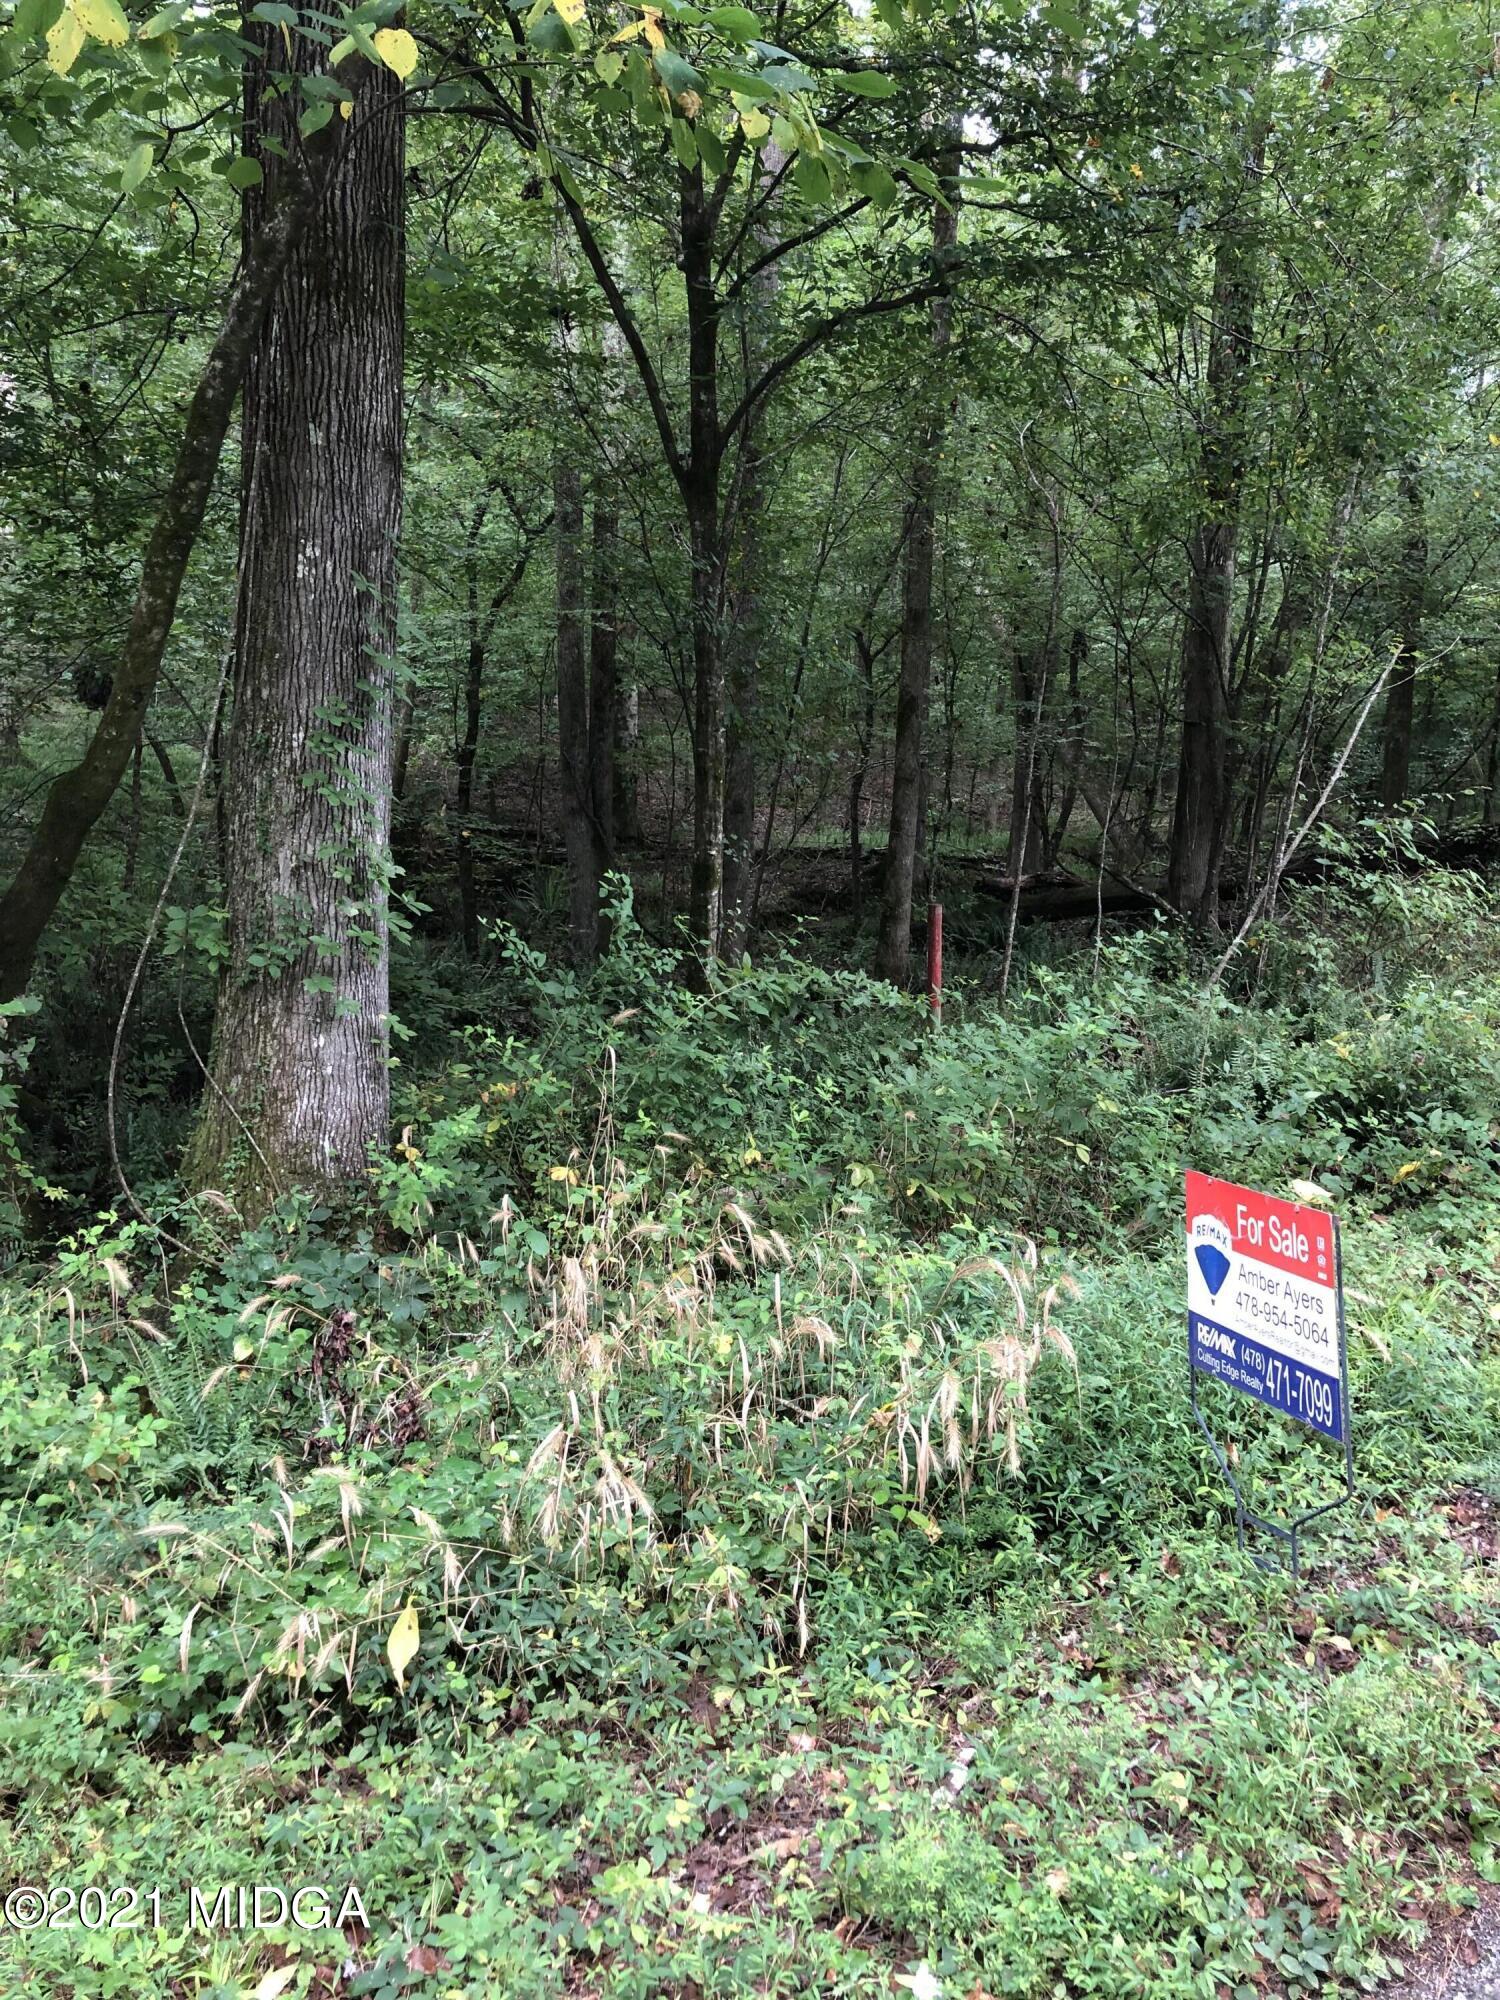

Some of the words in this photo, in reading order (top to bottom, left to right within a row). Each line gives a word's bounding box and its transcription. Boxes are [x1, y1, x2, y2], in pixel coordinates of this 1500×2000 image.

[1196, 1224, 1228, 1248] RE/MAX
[1236, 1203, 1265, 1247] For
[1268, 1215, 1309, 1264] Sale
[1238, 1263, 1280, 1297] Amber
[1284, 1281, 1324, 1315] Ayers
[1197, 1321, 1236, 1360] RE/MAX
[1235, 1291, 1329, 1348] 478-954-5064
[1197, 1347, 1220, 1373] Cutting
[1221, 1359, 1240, 1381] Edge
[1240, 1369, 1264, 1395] Realty
[1241, 1344, 1265, 1376] (478)
[1265, 1357, 1333, 1428] 471-7099
